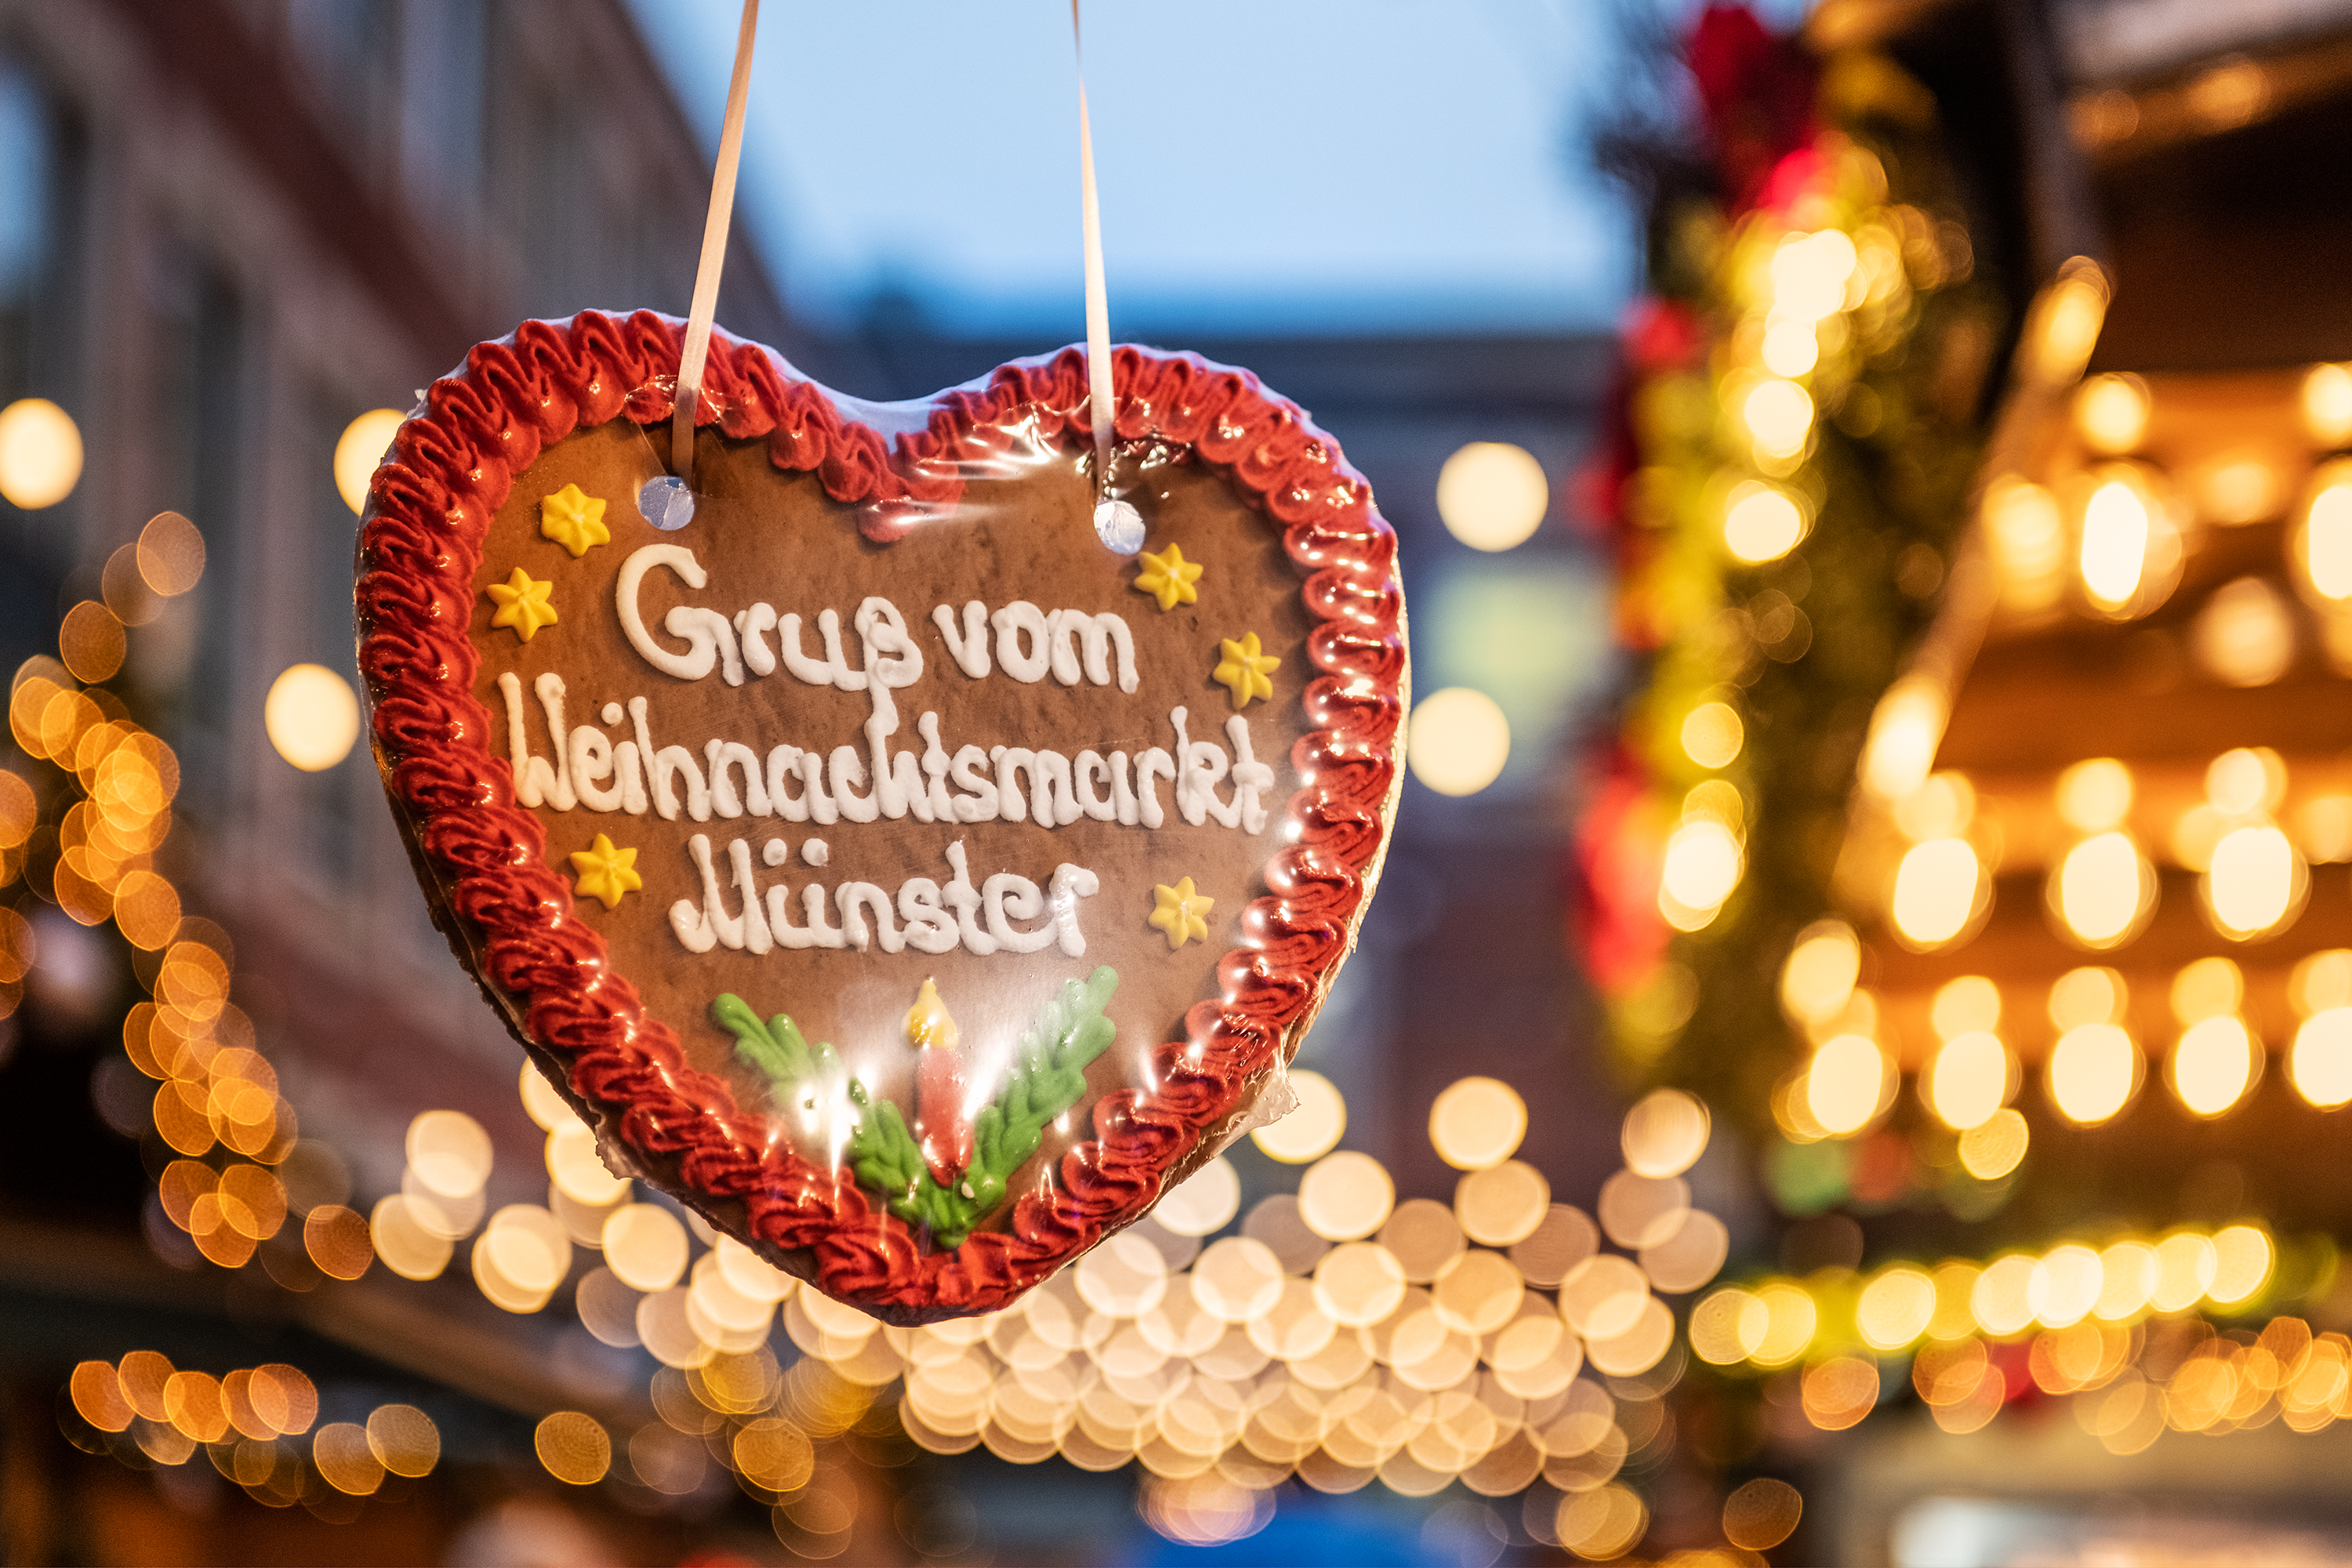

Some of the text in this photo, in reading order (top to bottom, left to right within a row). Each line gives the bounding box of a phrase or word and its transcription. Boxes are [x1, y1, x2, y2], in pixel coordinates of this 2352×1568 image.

[615, 543, 1139, 712] Gruß vom
[497, 671, 1275, 835] Weihnachtsmarkt
[668, 833, 1099, 957] Münster
